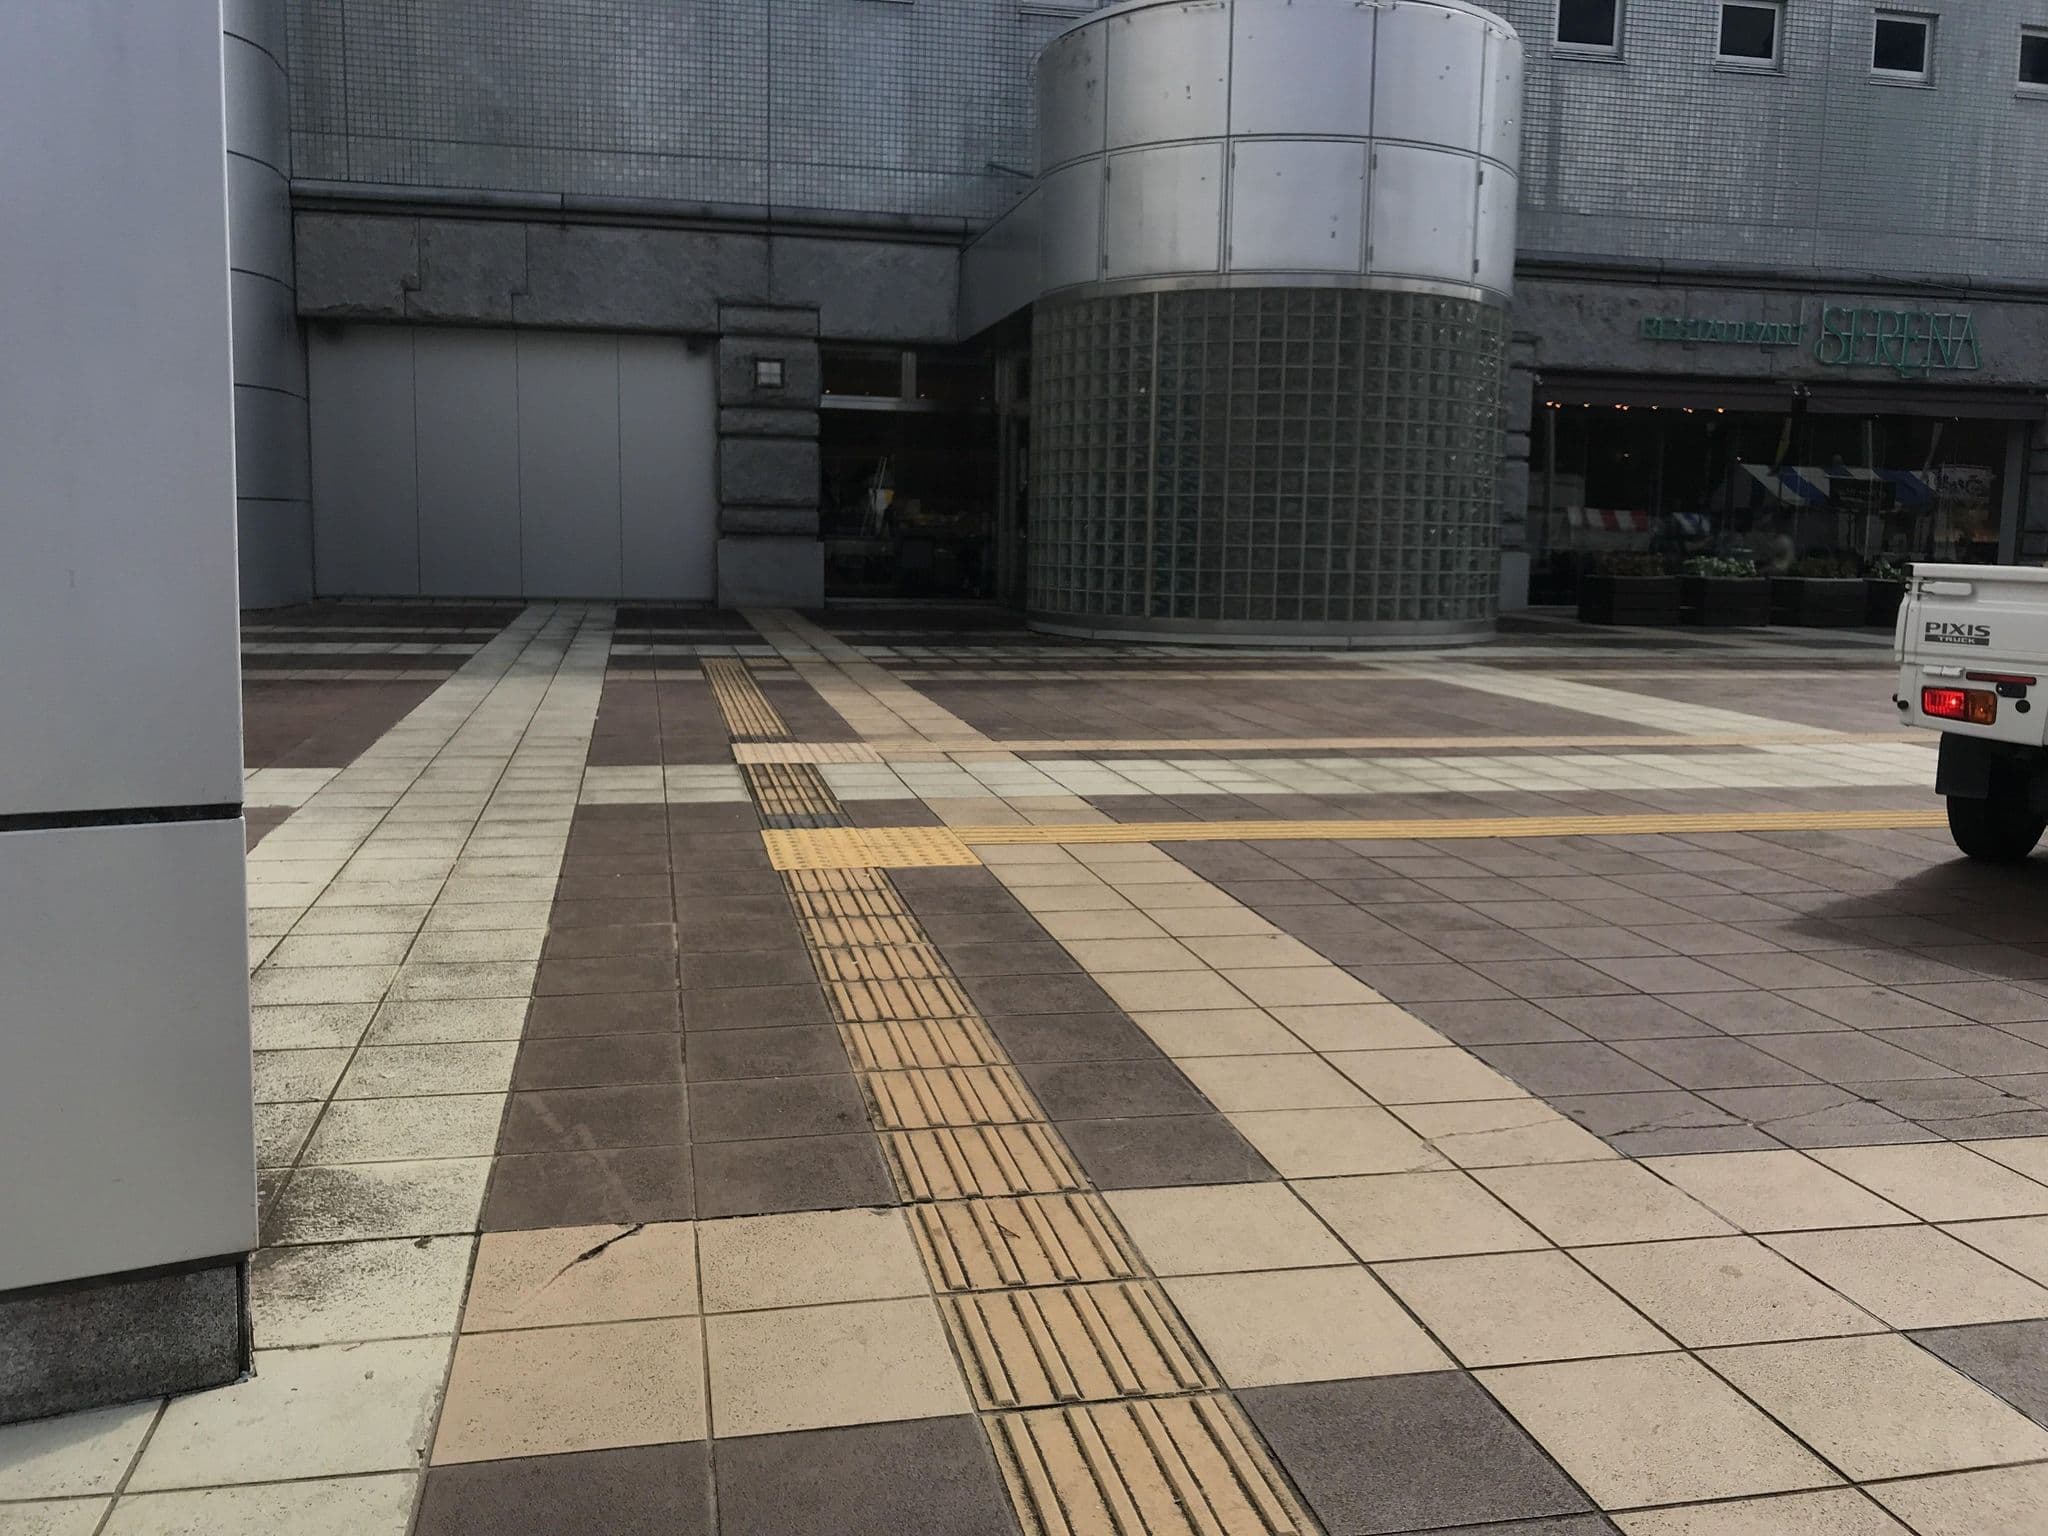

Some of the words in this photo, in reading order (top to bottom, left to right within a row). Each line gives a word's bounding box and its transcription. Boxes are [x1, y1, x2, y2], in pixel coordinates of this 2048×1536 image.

[1640, 316, 1806, 345] RESTAURANT
[1814, 307, 1983, 378] SERENA
[1925, 622, 1991, 637] PIXIS
[1939, 635, 1976, 646] TRUCK
